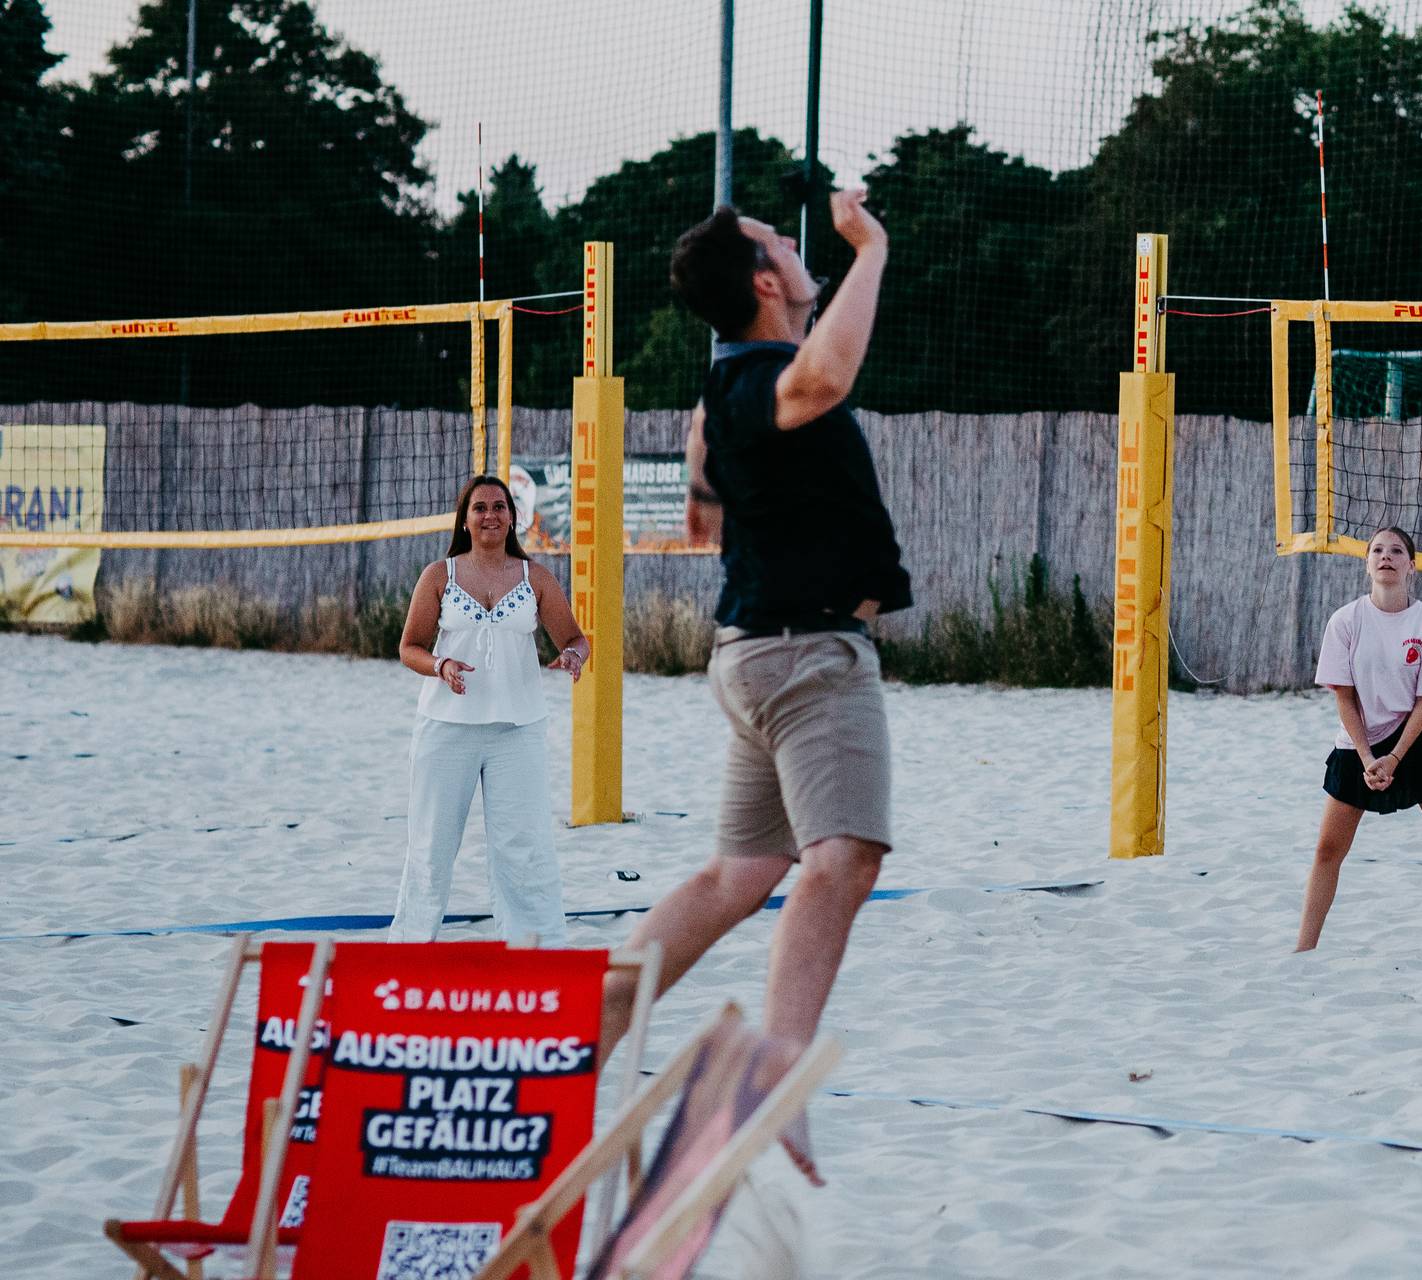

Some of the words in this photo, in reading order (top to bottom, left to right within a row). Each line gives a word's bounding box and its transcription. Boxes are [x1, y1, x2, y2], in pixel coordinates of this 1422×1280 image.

[111, 321, 179, 335] FUNTEC
[343, 308, 417, 324] FUNTEC
[1137, 256, 1150, 373] UNTEC
[656, 462, 681, 483] DER
[0, 484, 83, 531] RAN!
[1114, 421, 1140, 692] FUNTEC
[404, 988, 560, 1013] BAUHAUS
[333, 1030, 593, 1072] AUSBILDUNGS-
[408, 1075, 514, 1112] PLATZ
[366, 1112, 548, 1152] GEFÄLLIG?
[372, 1154, 534, 1179] #TeamBAUHAUS
